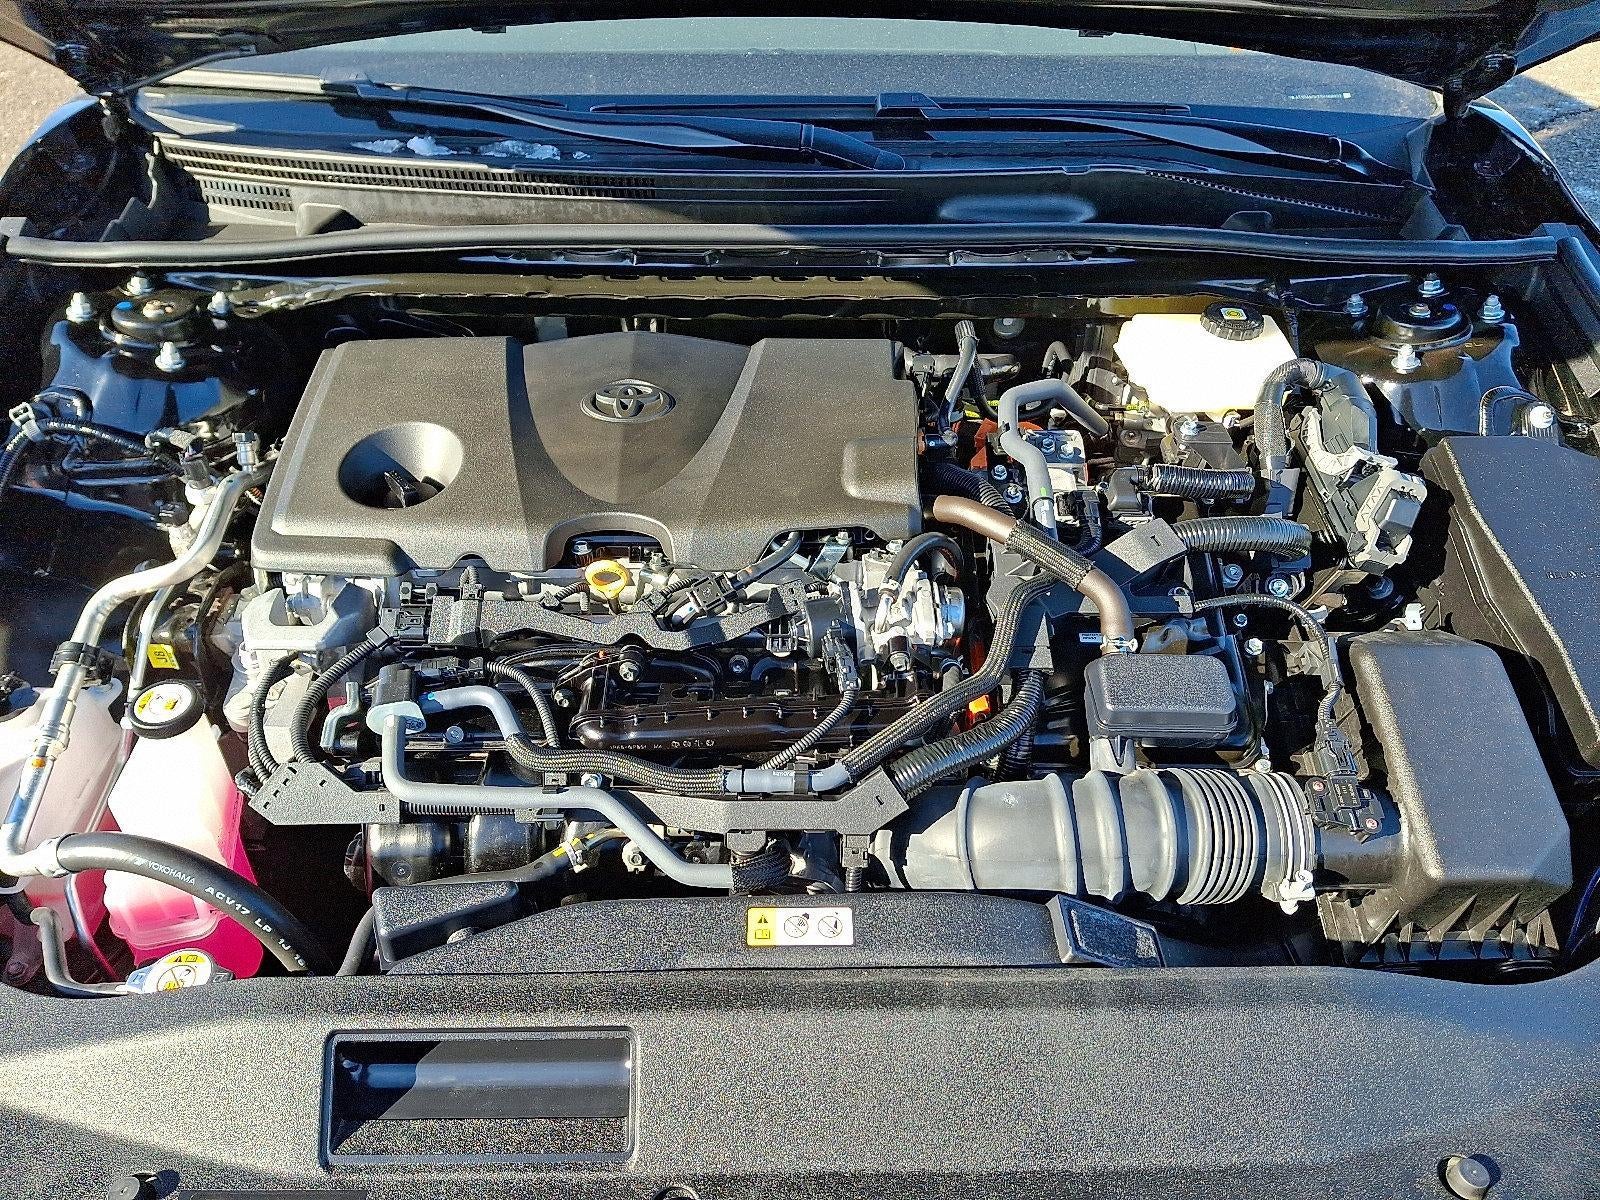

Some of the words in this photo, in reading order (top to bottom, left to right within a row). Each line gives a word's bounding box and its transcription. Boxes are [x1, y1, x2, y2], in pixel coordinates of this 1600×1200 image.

[148, 860, 196, 885] YOKOHAMA
[204, 886, 250, 915] ACV17
[254, 917, 272, 933] LP
